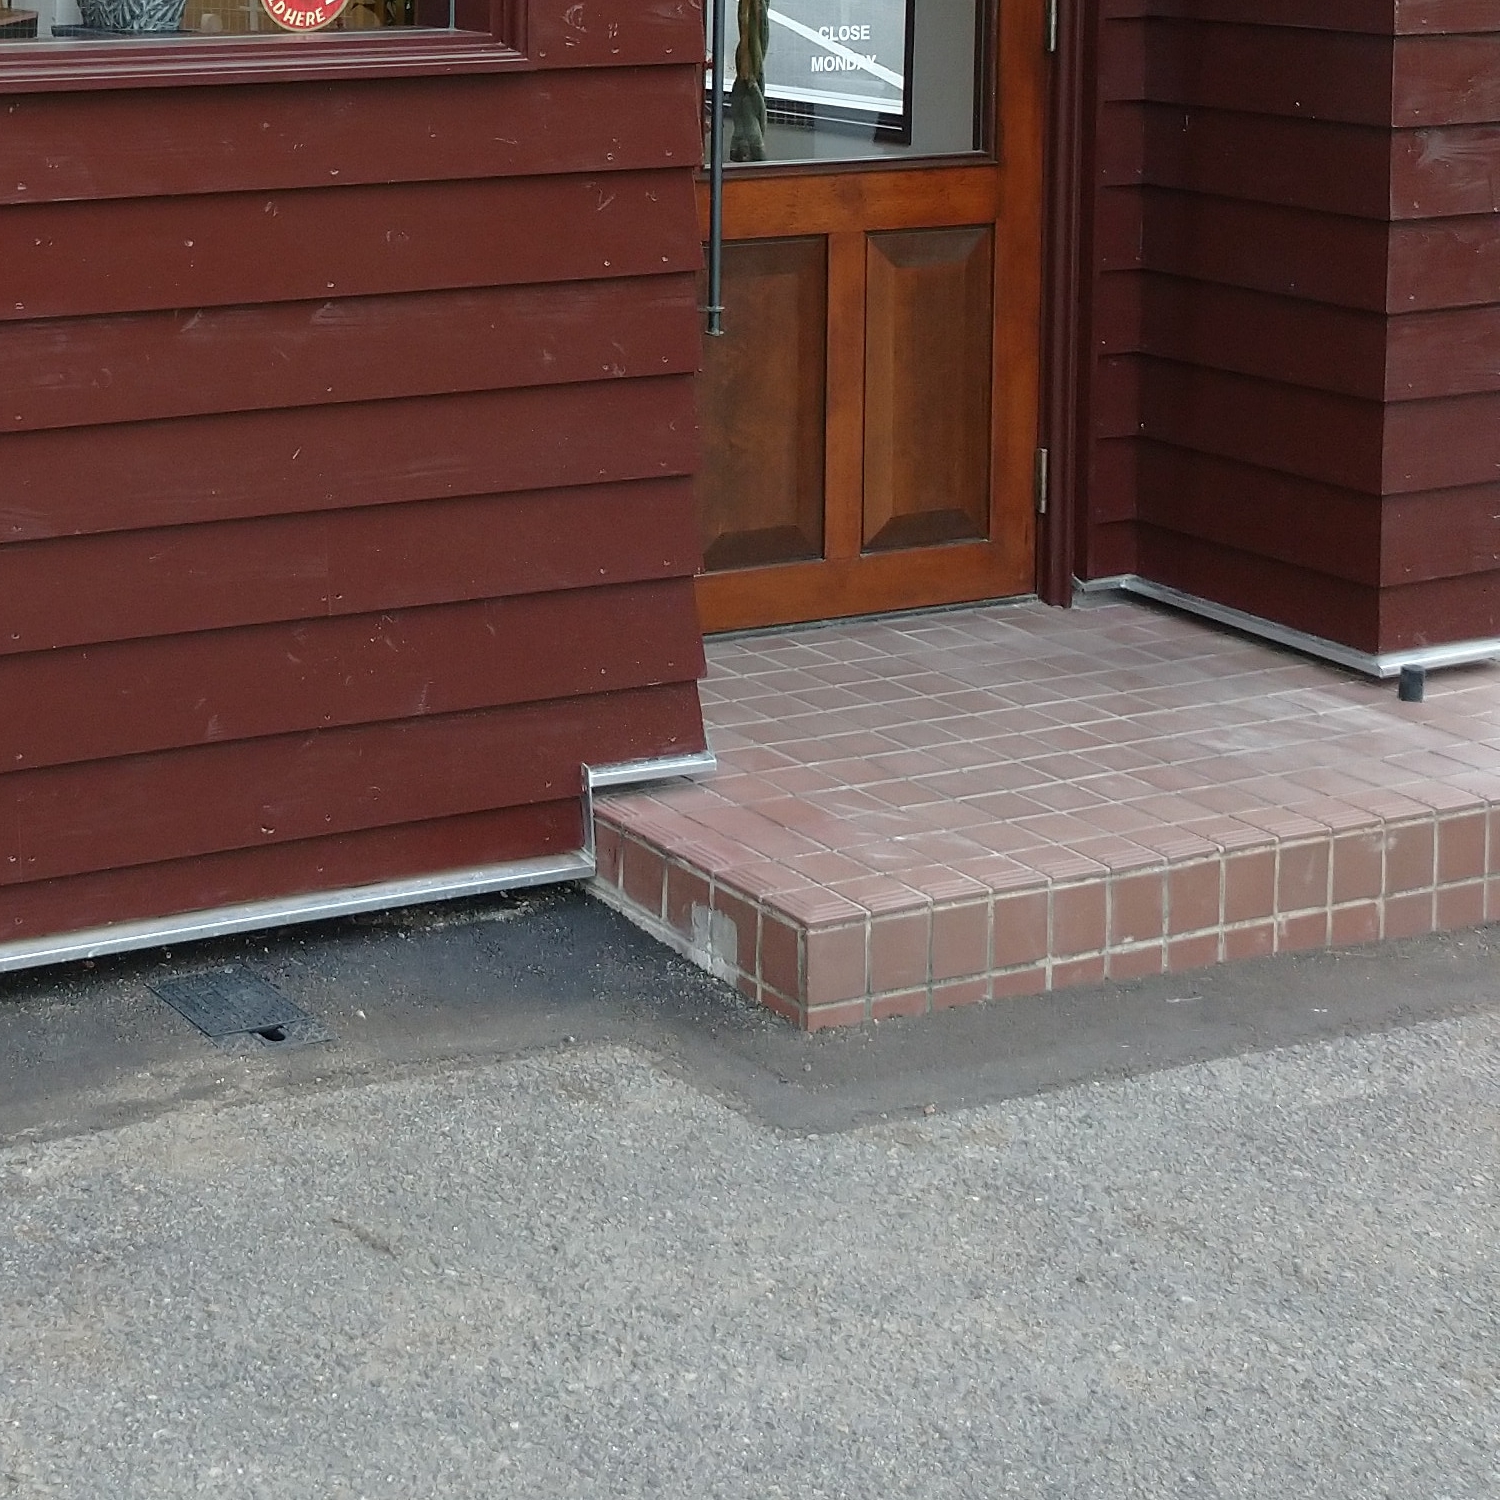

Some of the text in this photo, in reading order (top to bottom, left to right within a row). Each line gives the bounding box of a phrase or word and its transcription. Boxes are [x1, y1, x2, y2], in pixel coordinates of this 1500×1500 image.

[283, 7, 326, 27] HERE
[818, 25, 871, 41] CLOSE
[811, 55, 876, 72] MONDY
